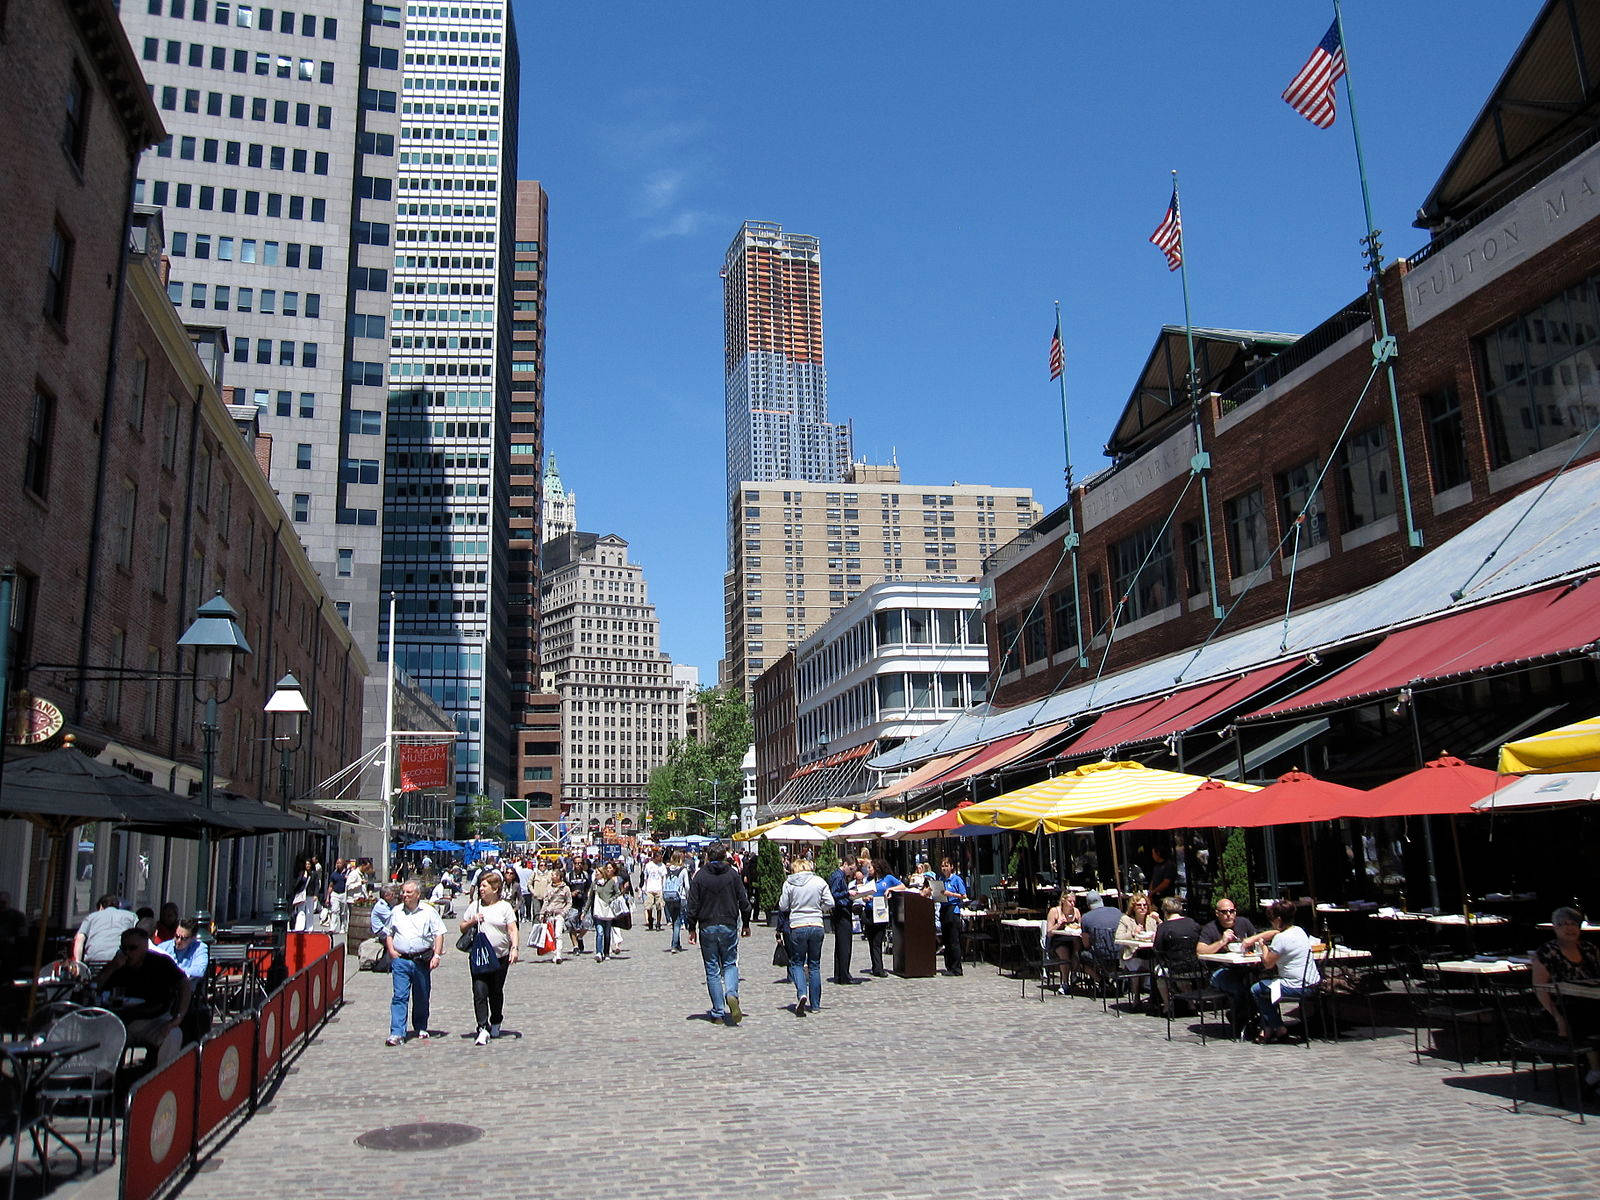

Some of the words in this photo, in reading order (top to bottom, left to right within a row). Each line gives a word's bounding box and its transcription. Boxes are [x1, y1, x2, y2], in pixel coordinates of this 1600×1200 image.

[1415, 220, 1520, 306] FULTON
[1135, 440, 1191, 487] MARKET
[401, 746, 446, 755] SEAPORT
[401, 752, 446, 762] MUSEUM
[476, 946, 490, 967] GAP
